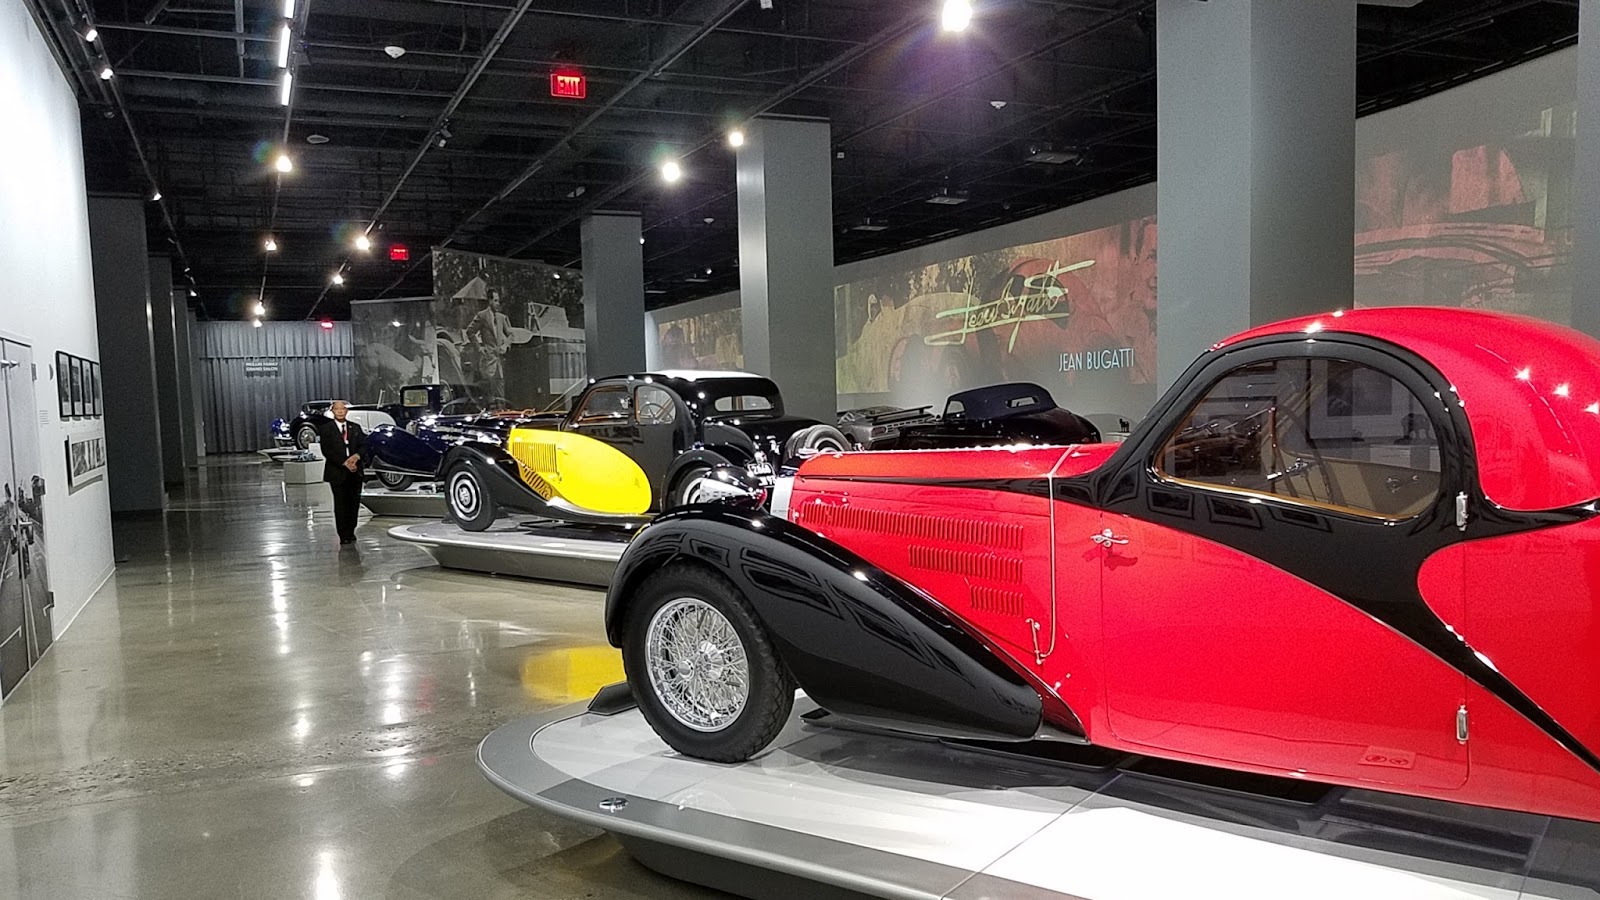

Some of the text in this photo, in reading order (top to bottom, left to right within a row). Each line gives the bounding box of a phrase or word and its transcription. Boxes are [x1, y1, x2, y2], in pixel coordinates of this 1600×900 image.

[557, 75, 580, 95] EXIT
[1058, 348, 1134, 372] JEAN BUGATTI
